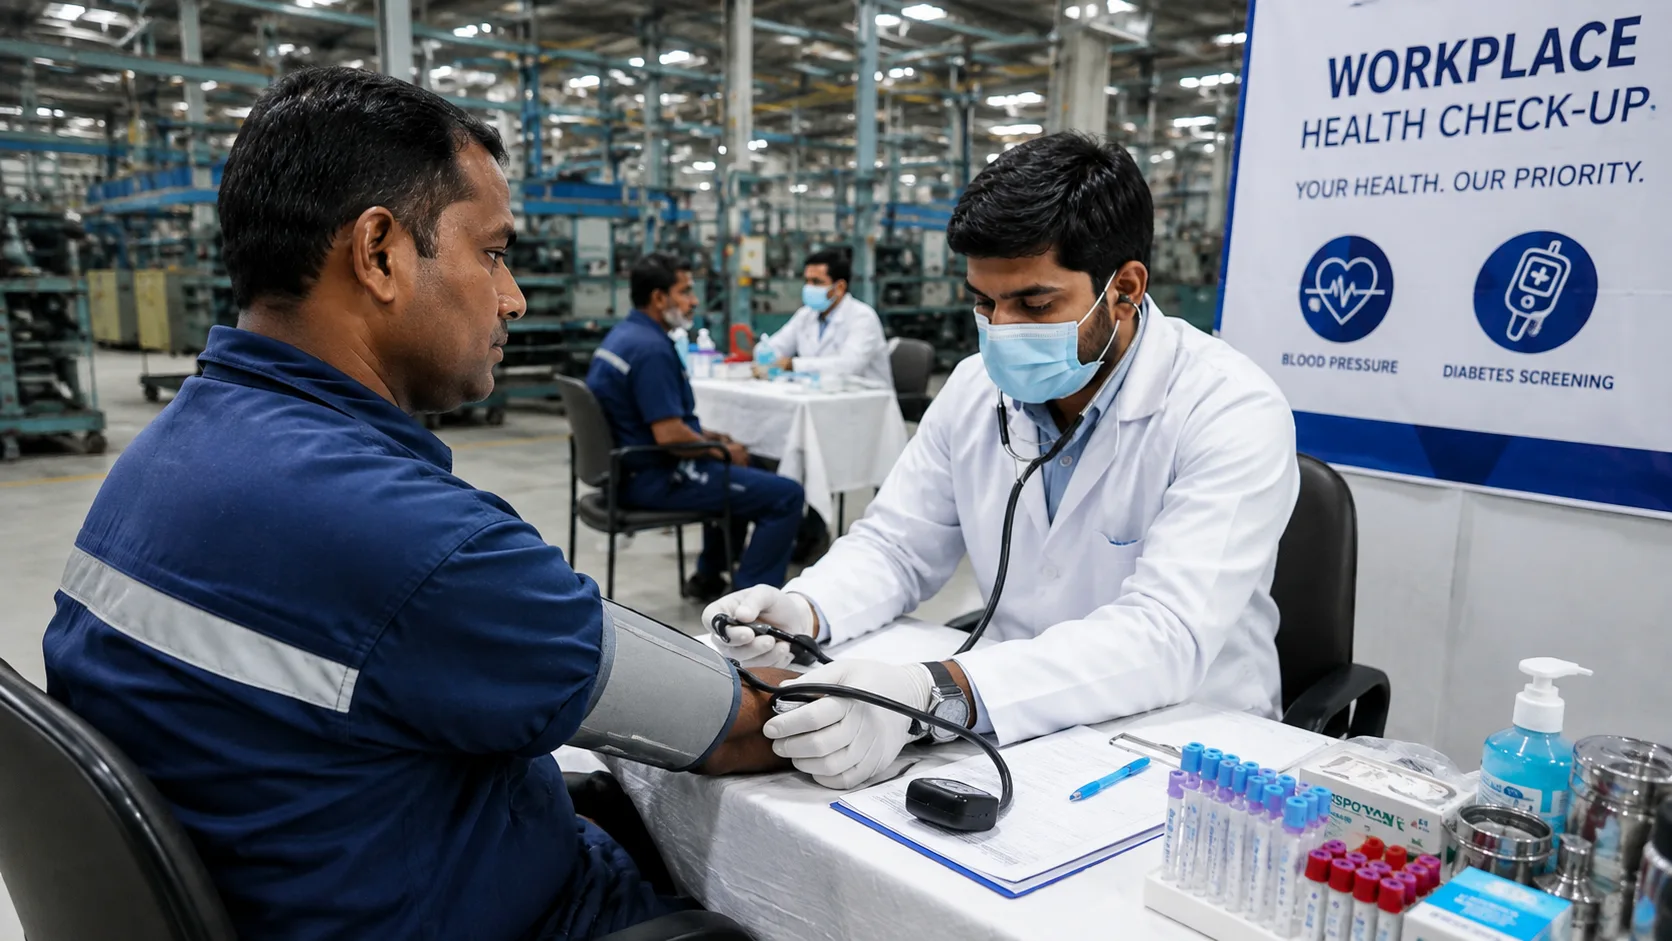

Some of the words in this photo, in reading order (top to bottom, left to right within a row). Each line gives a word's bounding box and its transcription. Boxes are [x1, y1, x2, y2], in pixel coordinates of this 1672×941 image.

[1327, 14, 1643, 100] WORKPLACE
[1300, 107, 1427, 150] HEALTH
[1295, 178, 1349, 200] YOUR
[1353, 172, 1445, 198] HEALTH.
[1453, 169, 1507, 193] OUR
[1513, 159, 1645, 189] PRIORITY.
[1281, 352, 1327, 369] BLOOD
[1328, 355, 1399, 375] PRESSURE
[1442, 363, 1515, 384] DIABETES
[1518, 368, 1615, 390] SCREENING
